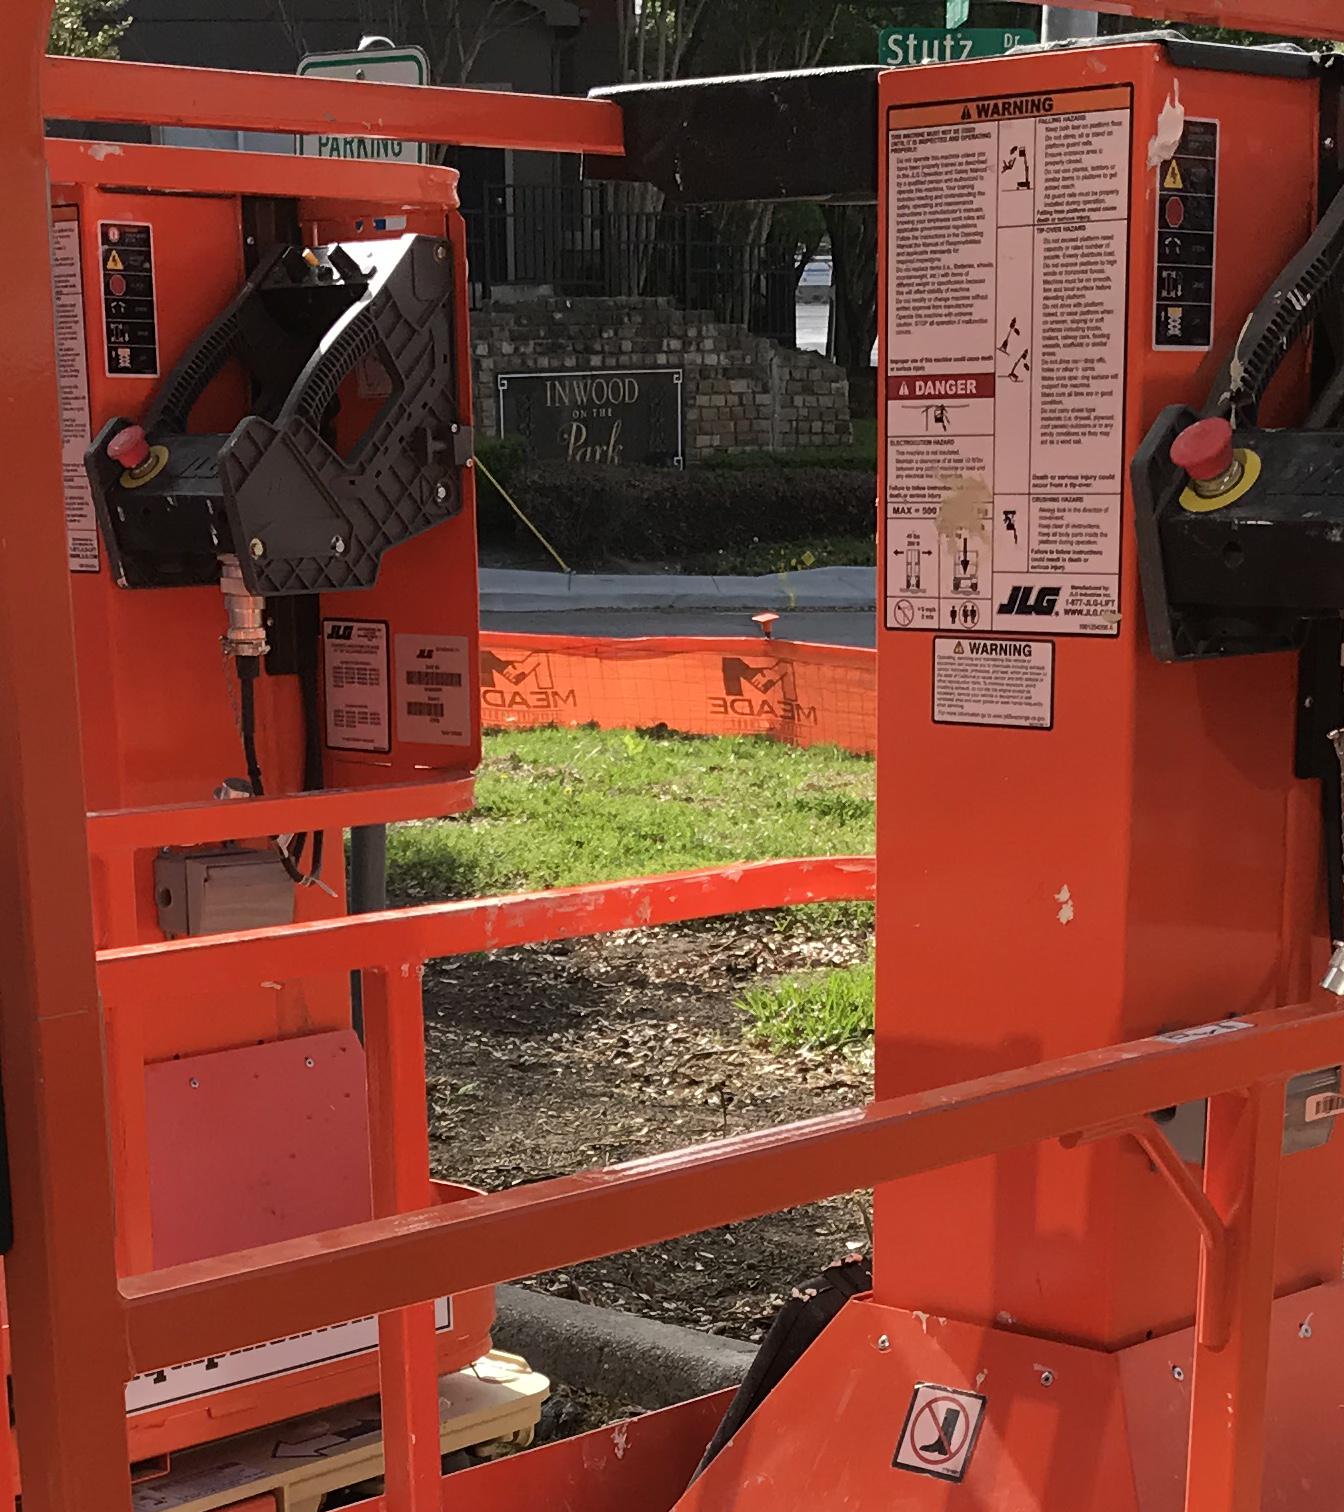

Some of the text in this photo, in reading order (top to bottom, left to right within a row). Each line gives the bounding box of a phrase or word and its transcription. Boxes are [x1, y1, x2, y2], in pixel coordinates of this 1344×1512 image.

[887, 33, 1021, 64] Stutz Dr
[976, 97, 1054, 118] WARNING
[319, 135, 403, 158] PARKING
[545, 378, 639, 407] INWOOD
[915, 380, 977, 396] DANGER
[572, 408, 613, 418] ON THE
[559, 419, 623, 465] Park
[892, 506, 912, 514] MAX
[922, 506, 937, 515] 500
[997, 585, 1062, 616] JLG
[327, 625, 354, 640] JLG
[969, 641, 1032, 658] WARNING
